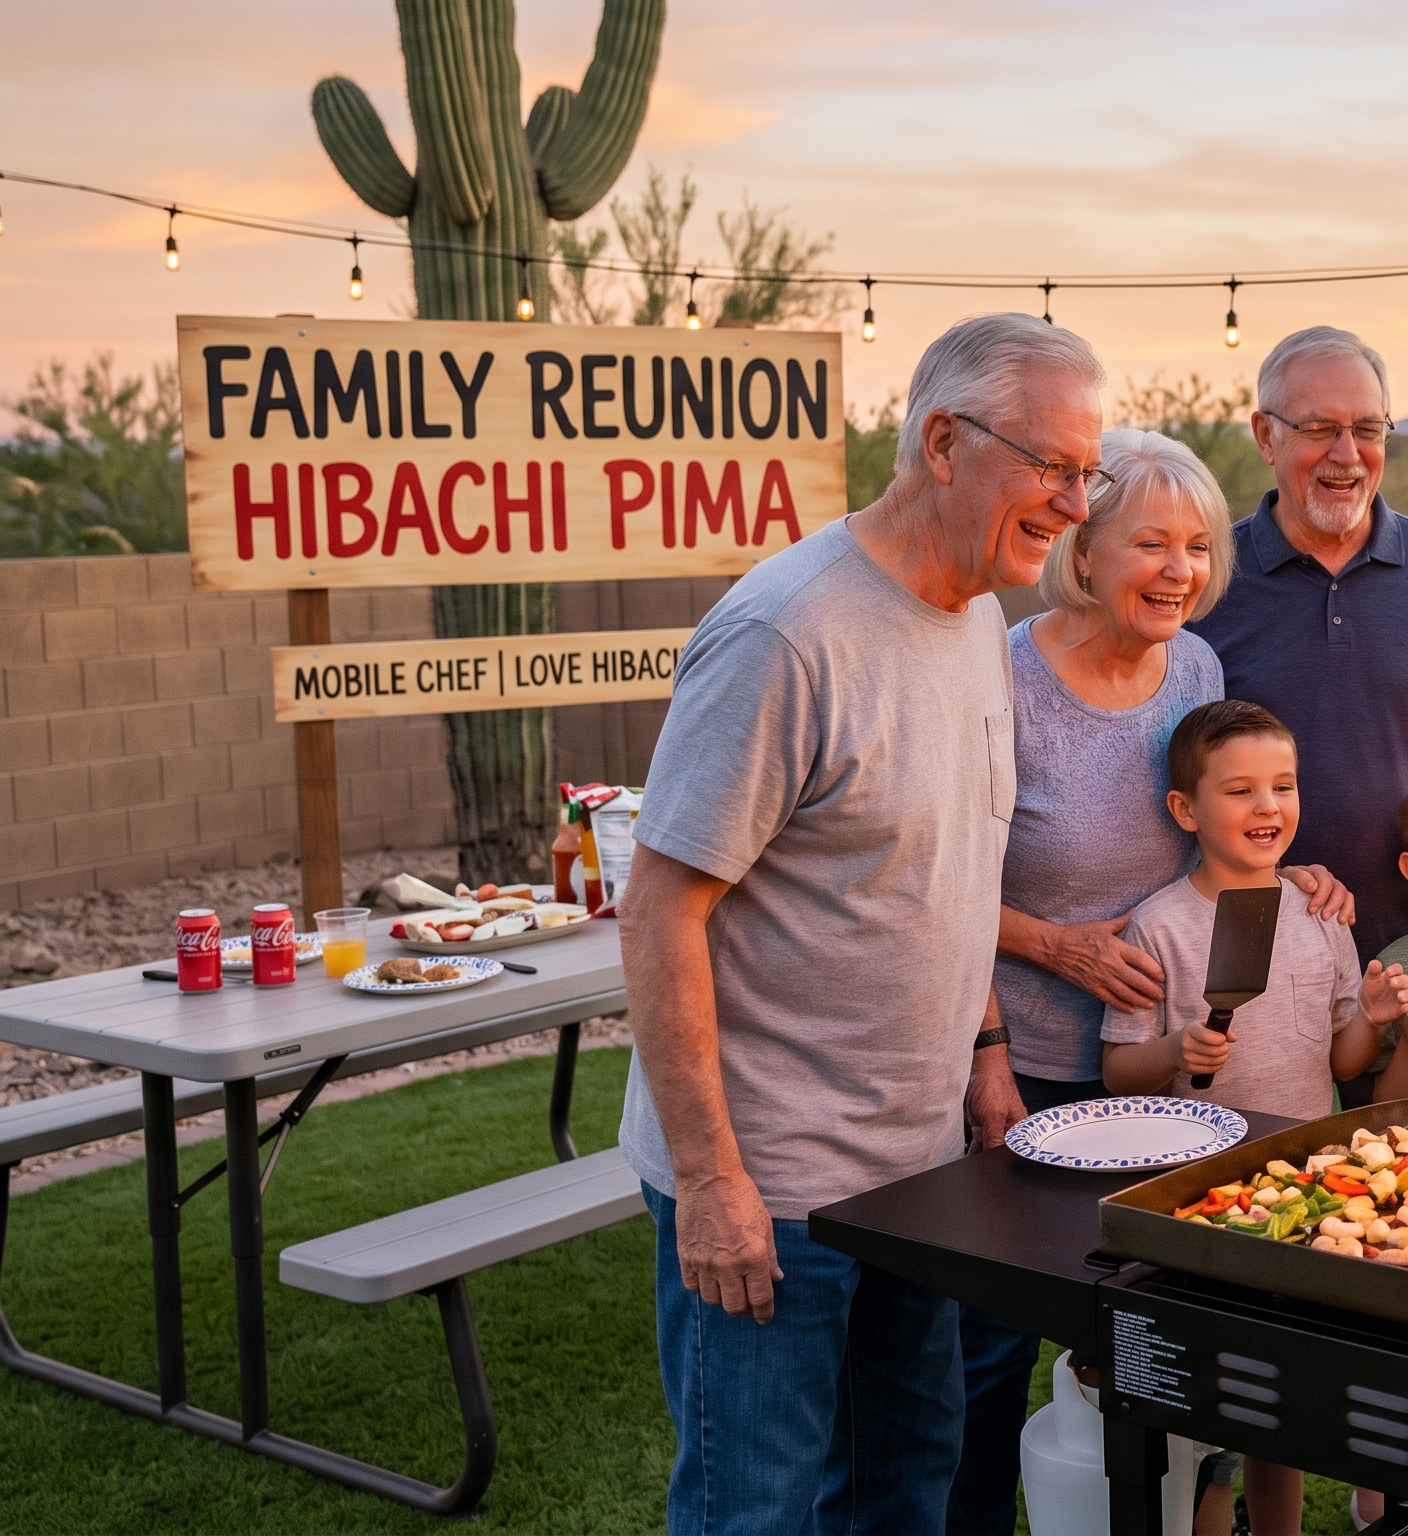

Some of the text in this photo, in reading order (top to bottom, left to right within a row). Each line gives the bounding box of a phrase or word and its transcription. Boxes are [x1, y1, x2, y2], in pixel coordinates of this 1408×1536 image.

[202, 344, 828, 441] FAMILY REUNION
[232, 458, 803, 561] HIBACHI PIMA
[294, 661, 407, 701] MOBILE
[416, 657, 488, 694] CHEF
[515, 652, 583, 687] LOVE
